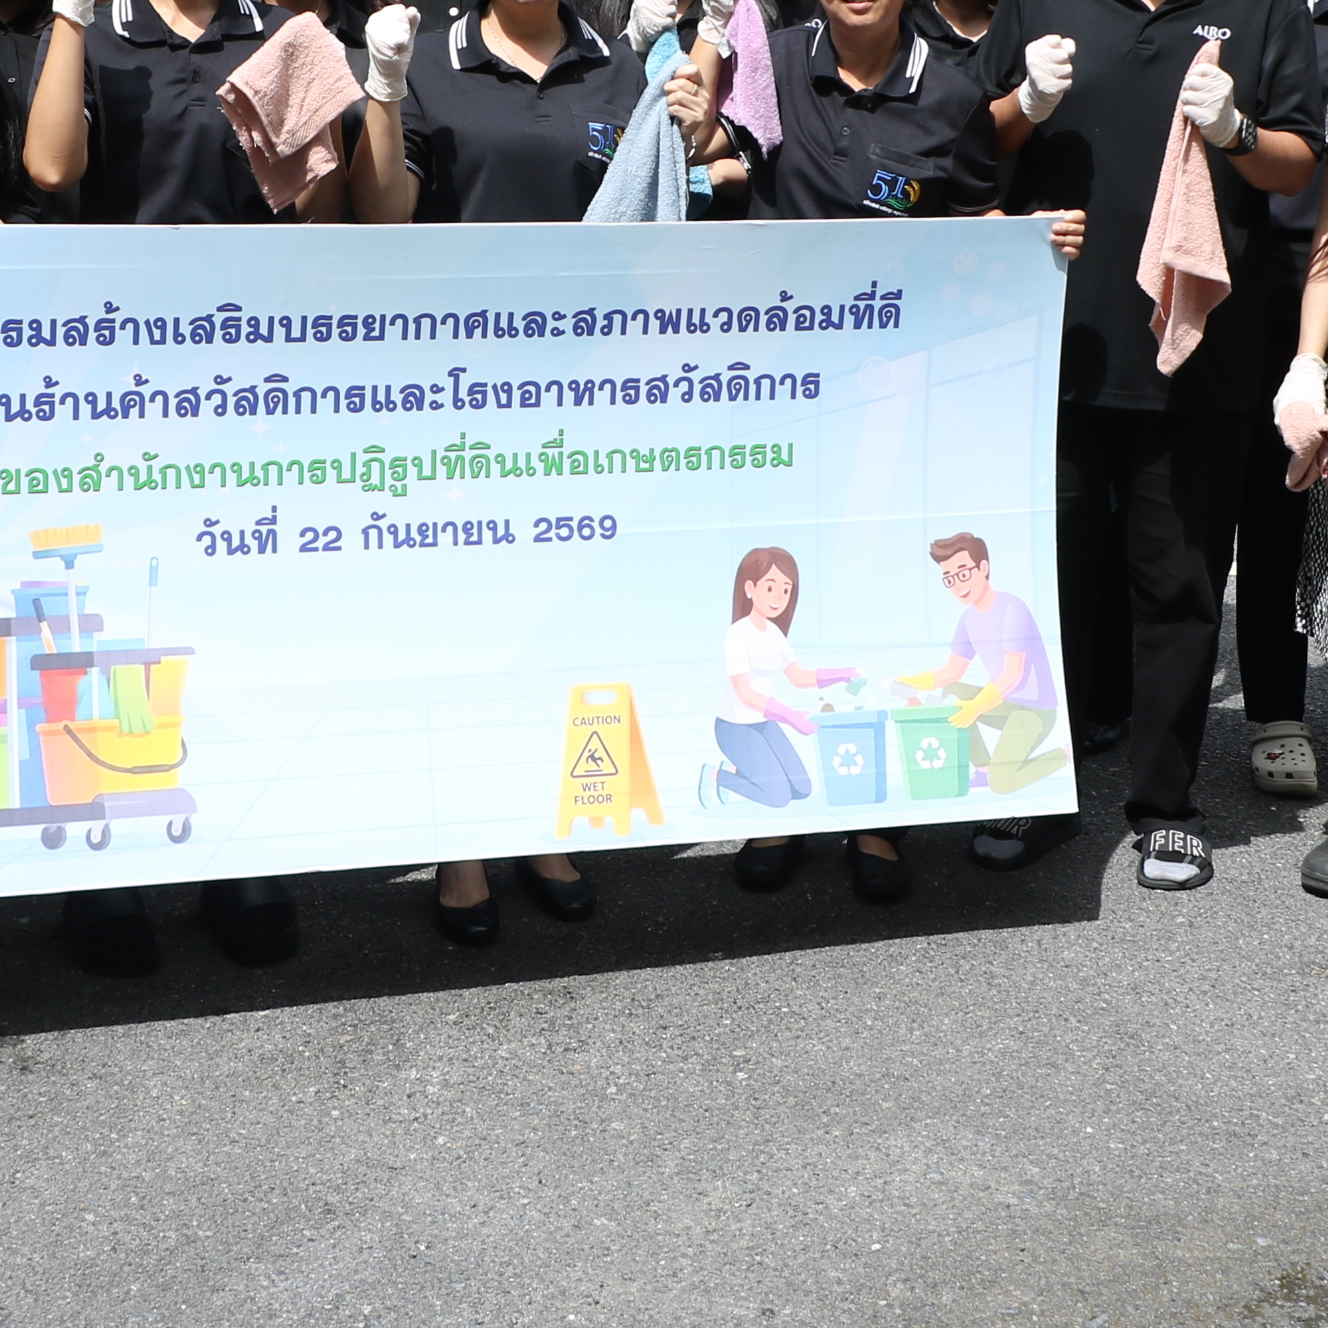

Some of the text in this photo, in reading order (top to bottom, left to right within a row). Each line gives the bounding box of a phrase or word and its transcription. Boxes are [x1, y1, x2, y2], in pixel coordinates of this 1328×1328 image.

[1192, 24, 1232, 41] ALRO
[588, 122, 616, 151] 51
[866, 169, 907, 200] 51
[195, 506, 618, 556] วันที่ 22 กันยายน 2569
[572, 715, 622, 727] CAUTION
[580, 781, 607, 793] WET
[574, 793, 613, 806] FLOOR
